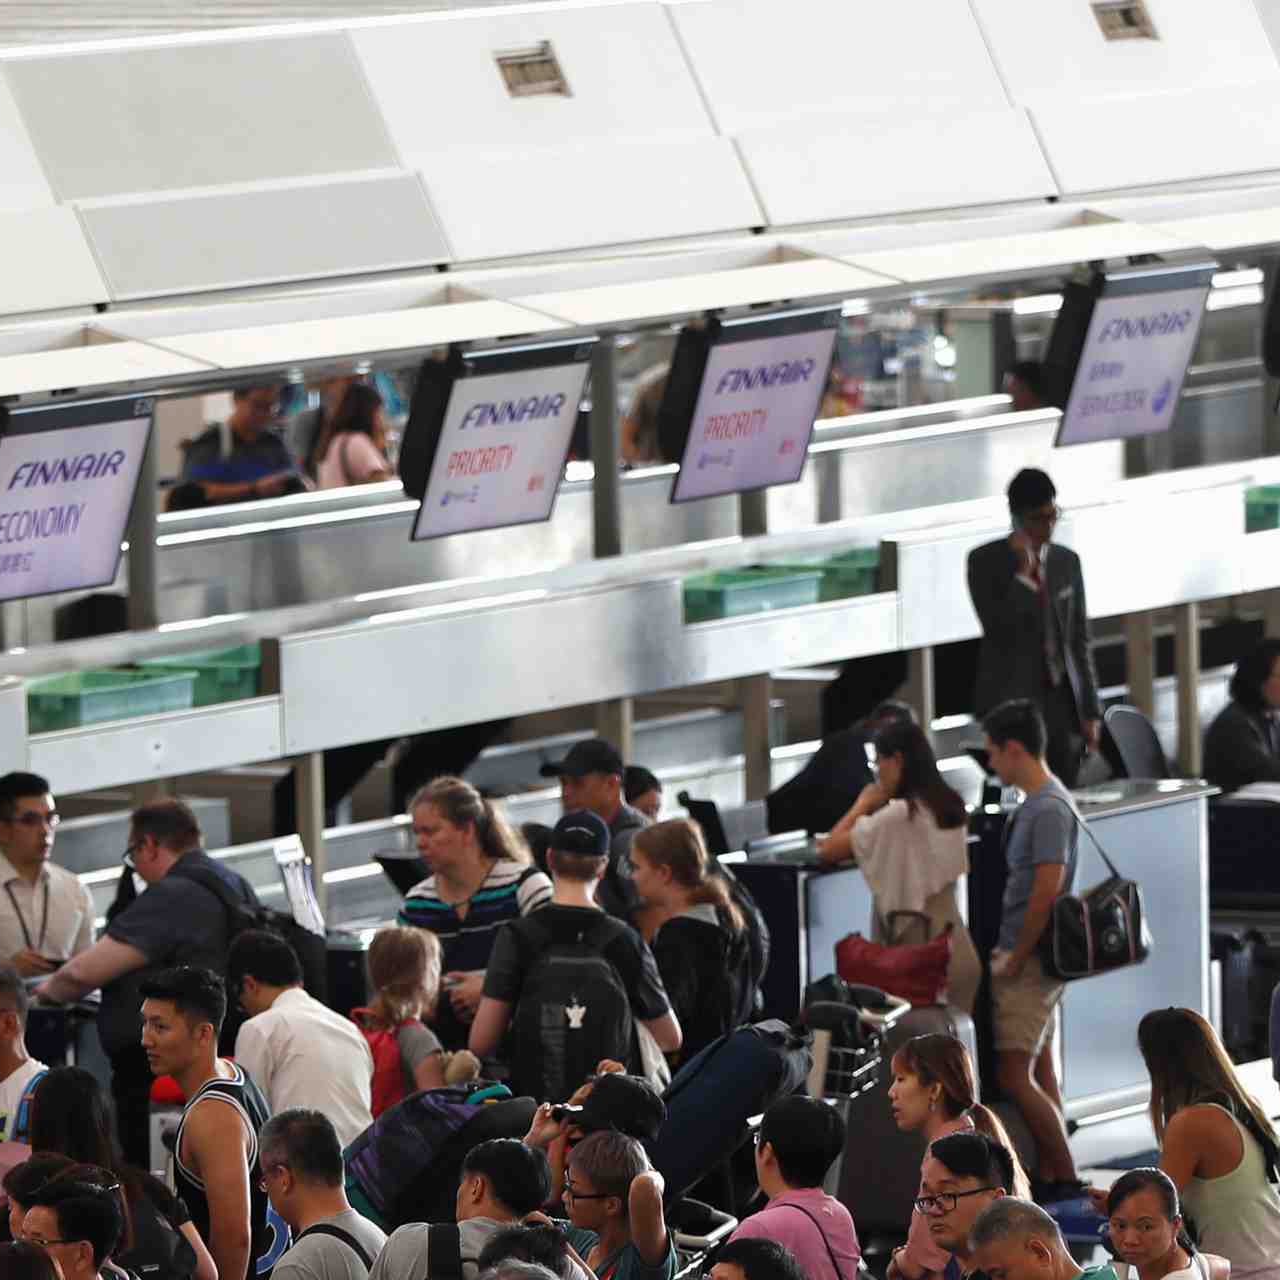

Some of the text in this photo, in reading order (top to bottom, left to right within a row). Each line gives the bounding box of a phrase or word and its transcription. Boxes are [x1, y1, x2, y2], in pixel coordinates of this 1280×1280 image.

[715, 358, 815, 395] FINNAIR
[459, 392, 566, 430] FINNAIR
[7, 450, 125, 490] FINNAIR
